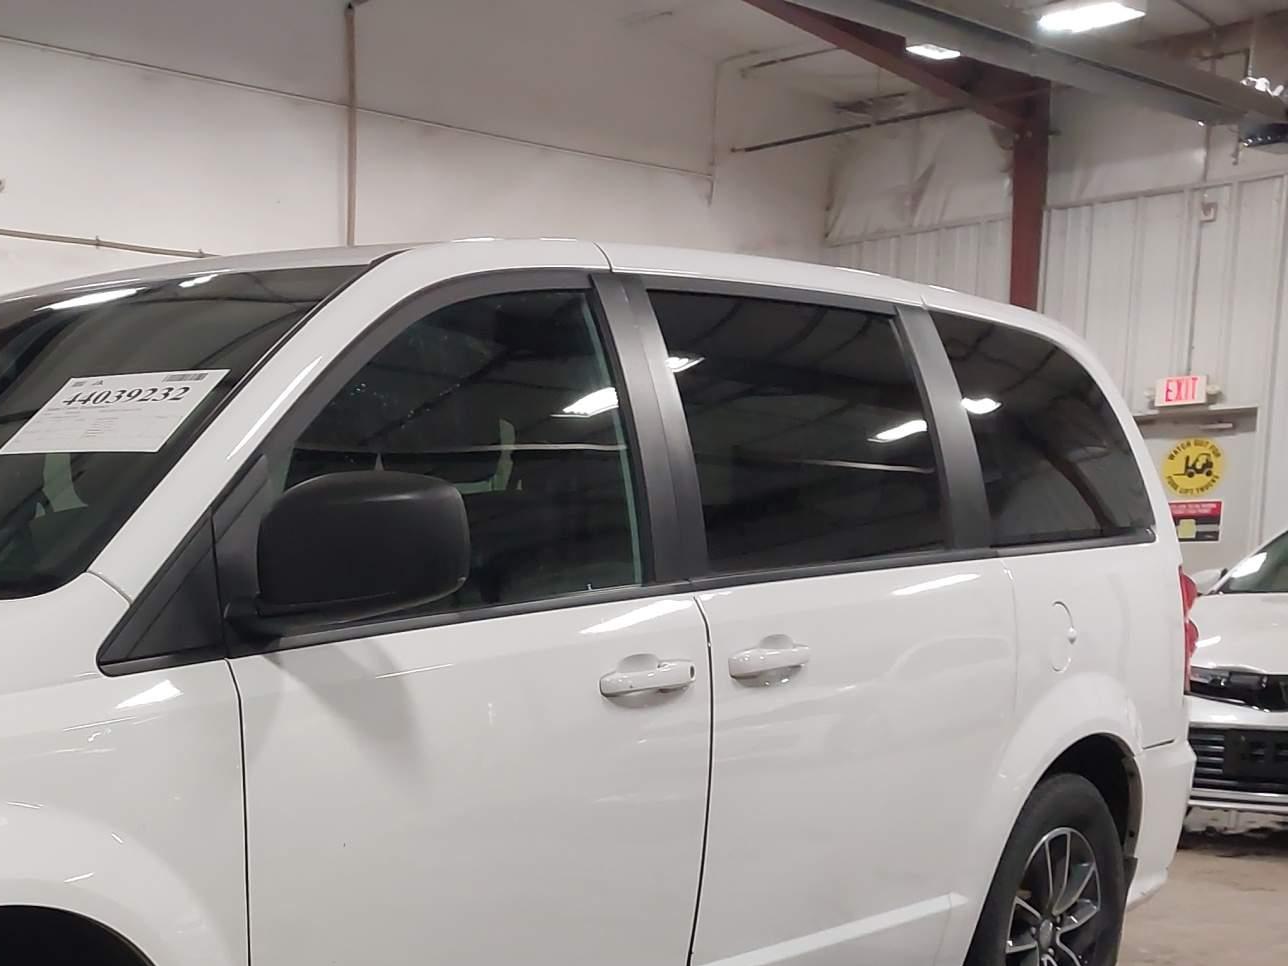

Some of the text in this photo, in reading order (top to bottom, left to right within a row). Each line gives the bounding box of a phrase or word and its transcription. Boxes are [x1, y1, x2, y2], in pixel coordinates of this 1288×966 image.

[63, 386, 191, 405] 44039232
[1165, 377, 1198, 402] EXIT
[1168, 440, 1191, 461] WATCH
